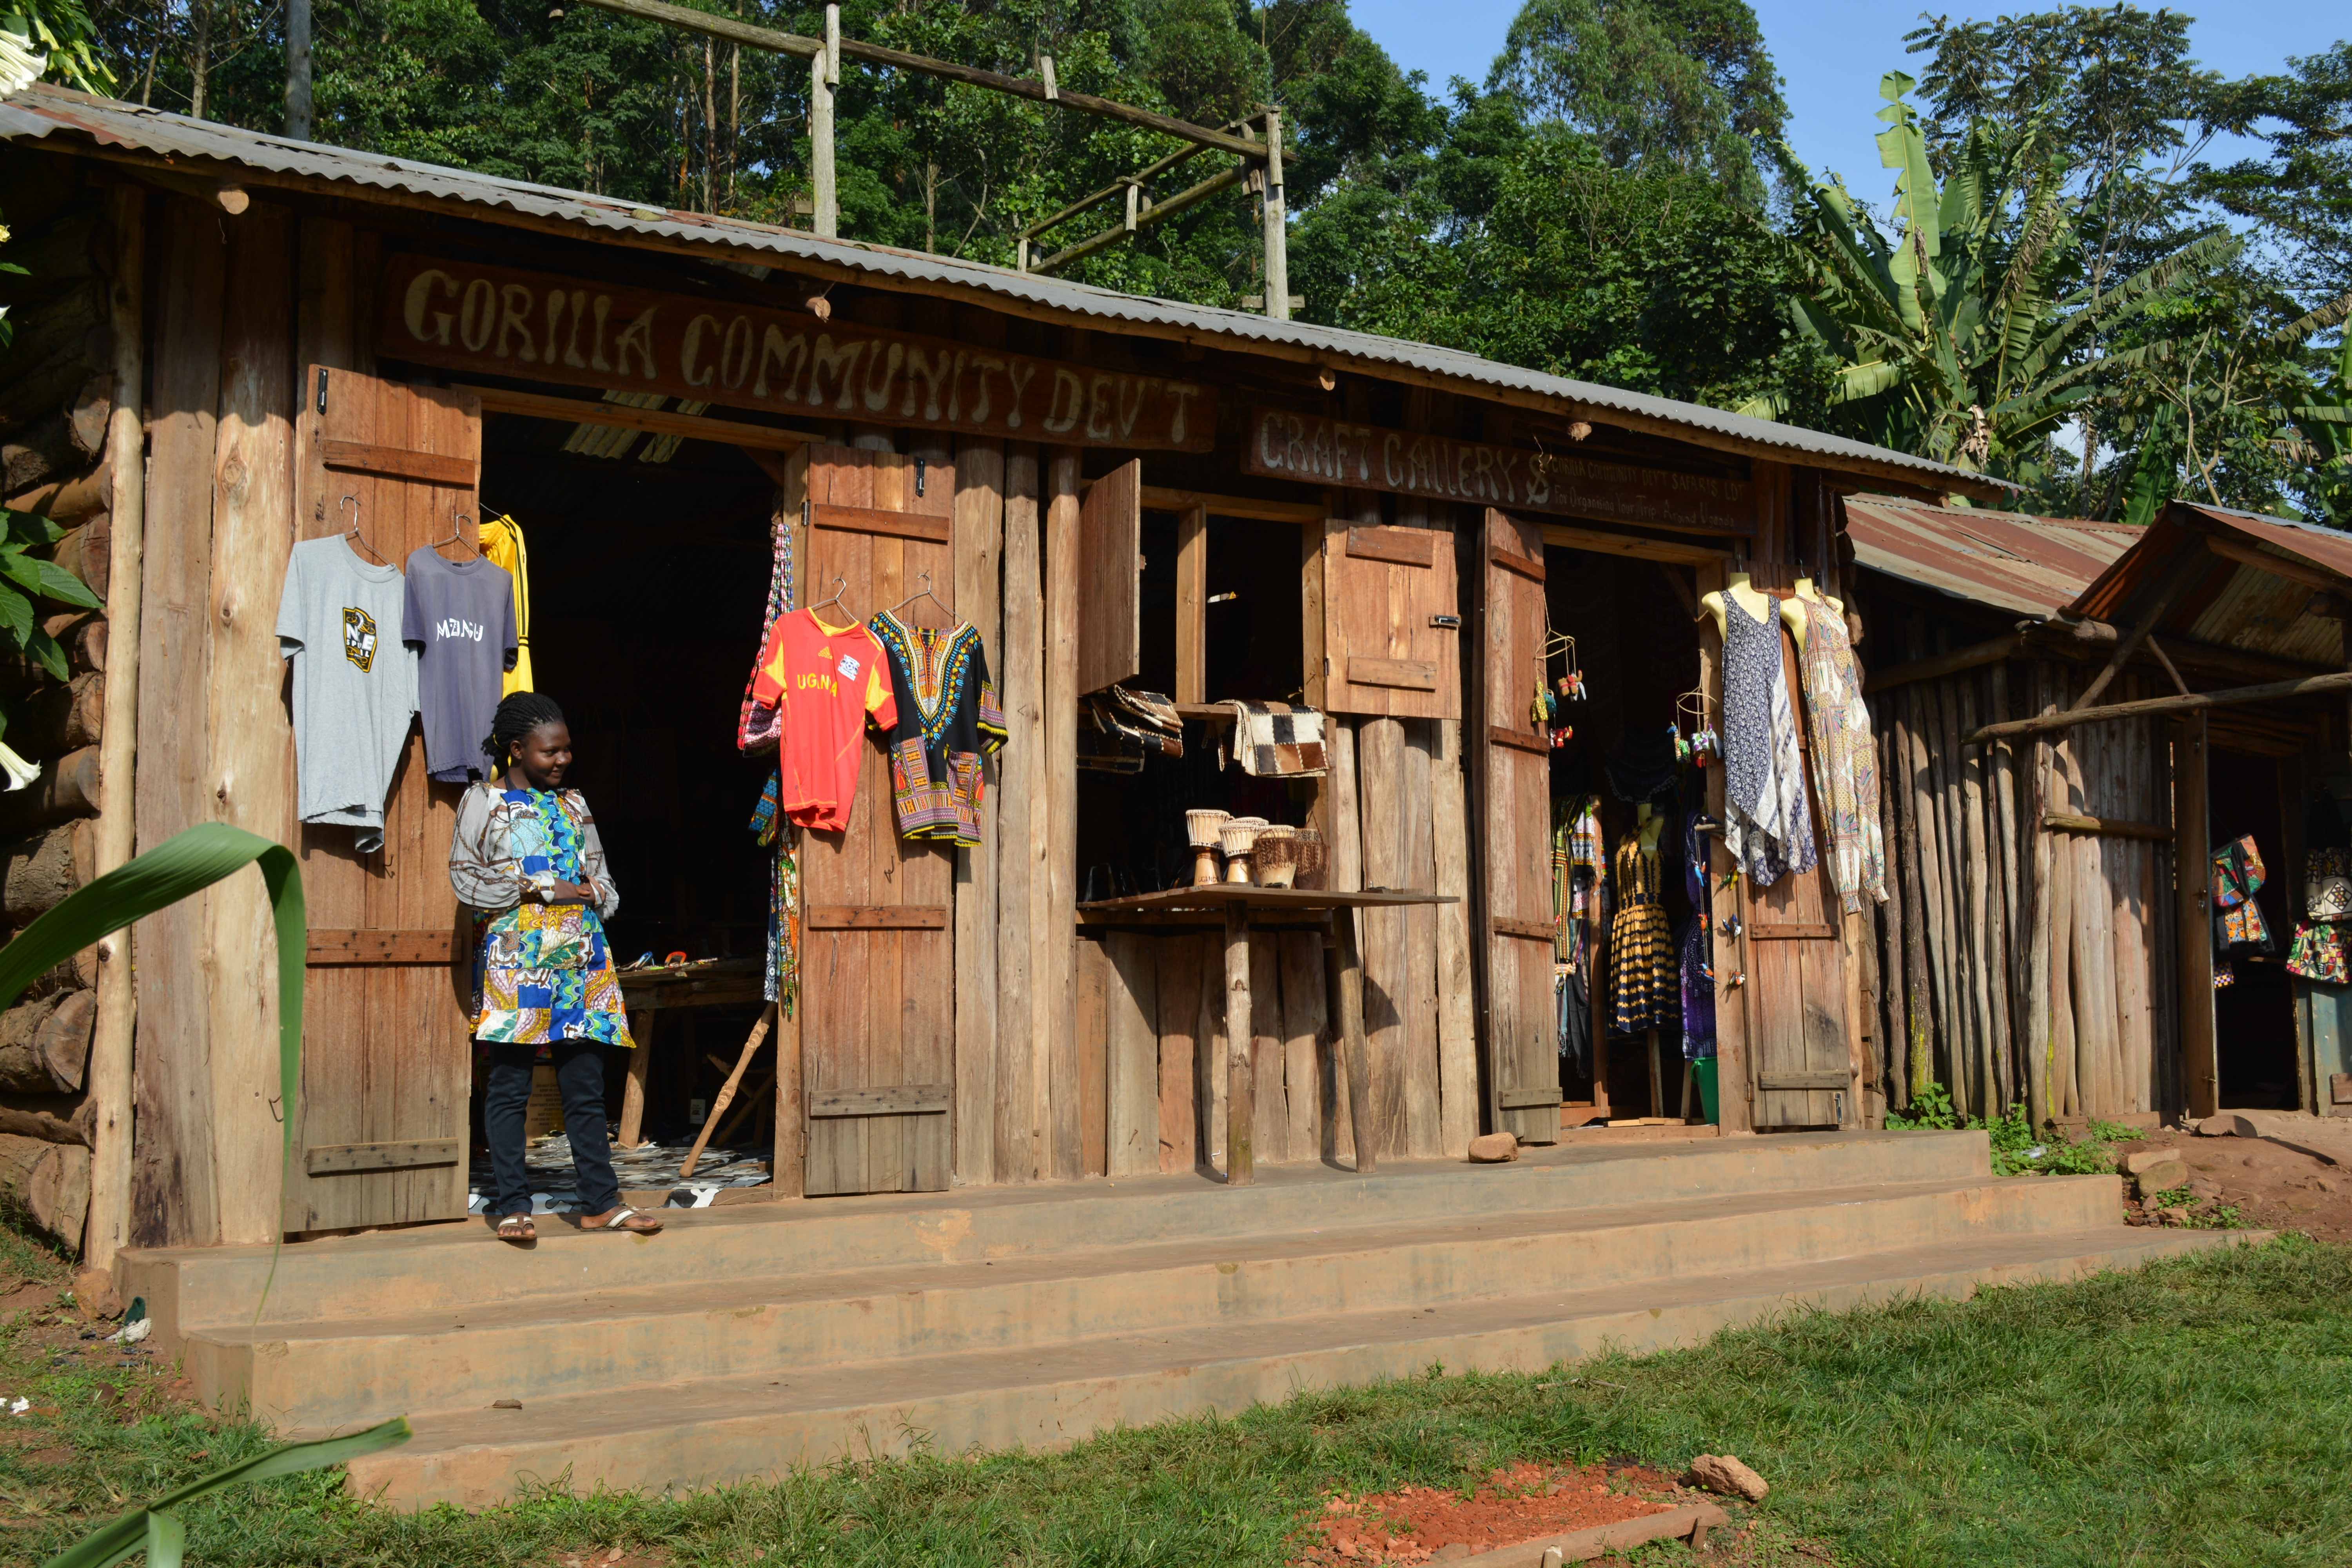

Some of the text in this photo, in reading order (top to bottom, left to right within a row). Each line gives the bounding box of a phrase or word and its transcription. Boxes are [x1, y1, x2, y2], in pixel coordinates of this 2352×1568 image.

[404, 269, 661, 380] GORILLA
[681, 314, 1037, 429] COMMUNITY
[1260, 412, 1373, 481] CRAFT
[1384, 433, 1519, 502] GALLERY
[1552, 457, 1586, 477] GORILLA
[1588, 462, 1638, 484] COMMUNITY
[1671, 473, 1718, 497] SAFARIS
[1724, 481, 1744, 501] LDT
[1554, 485, 1734, 529] For Organising Your Trip Around Uganda
[797, 673, 837, 697] UGNA
